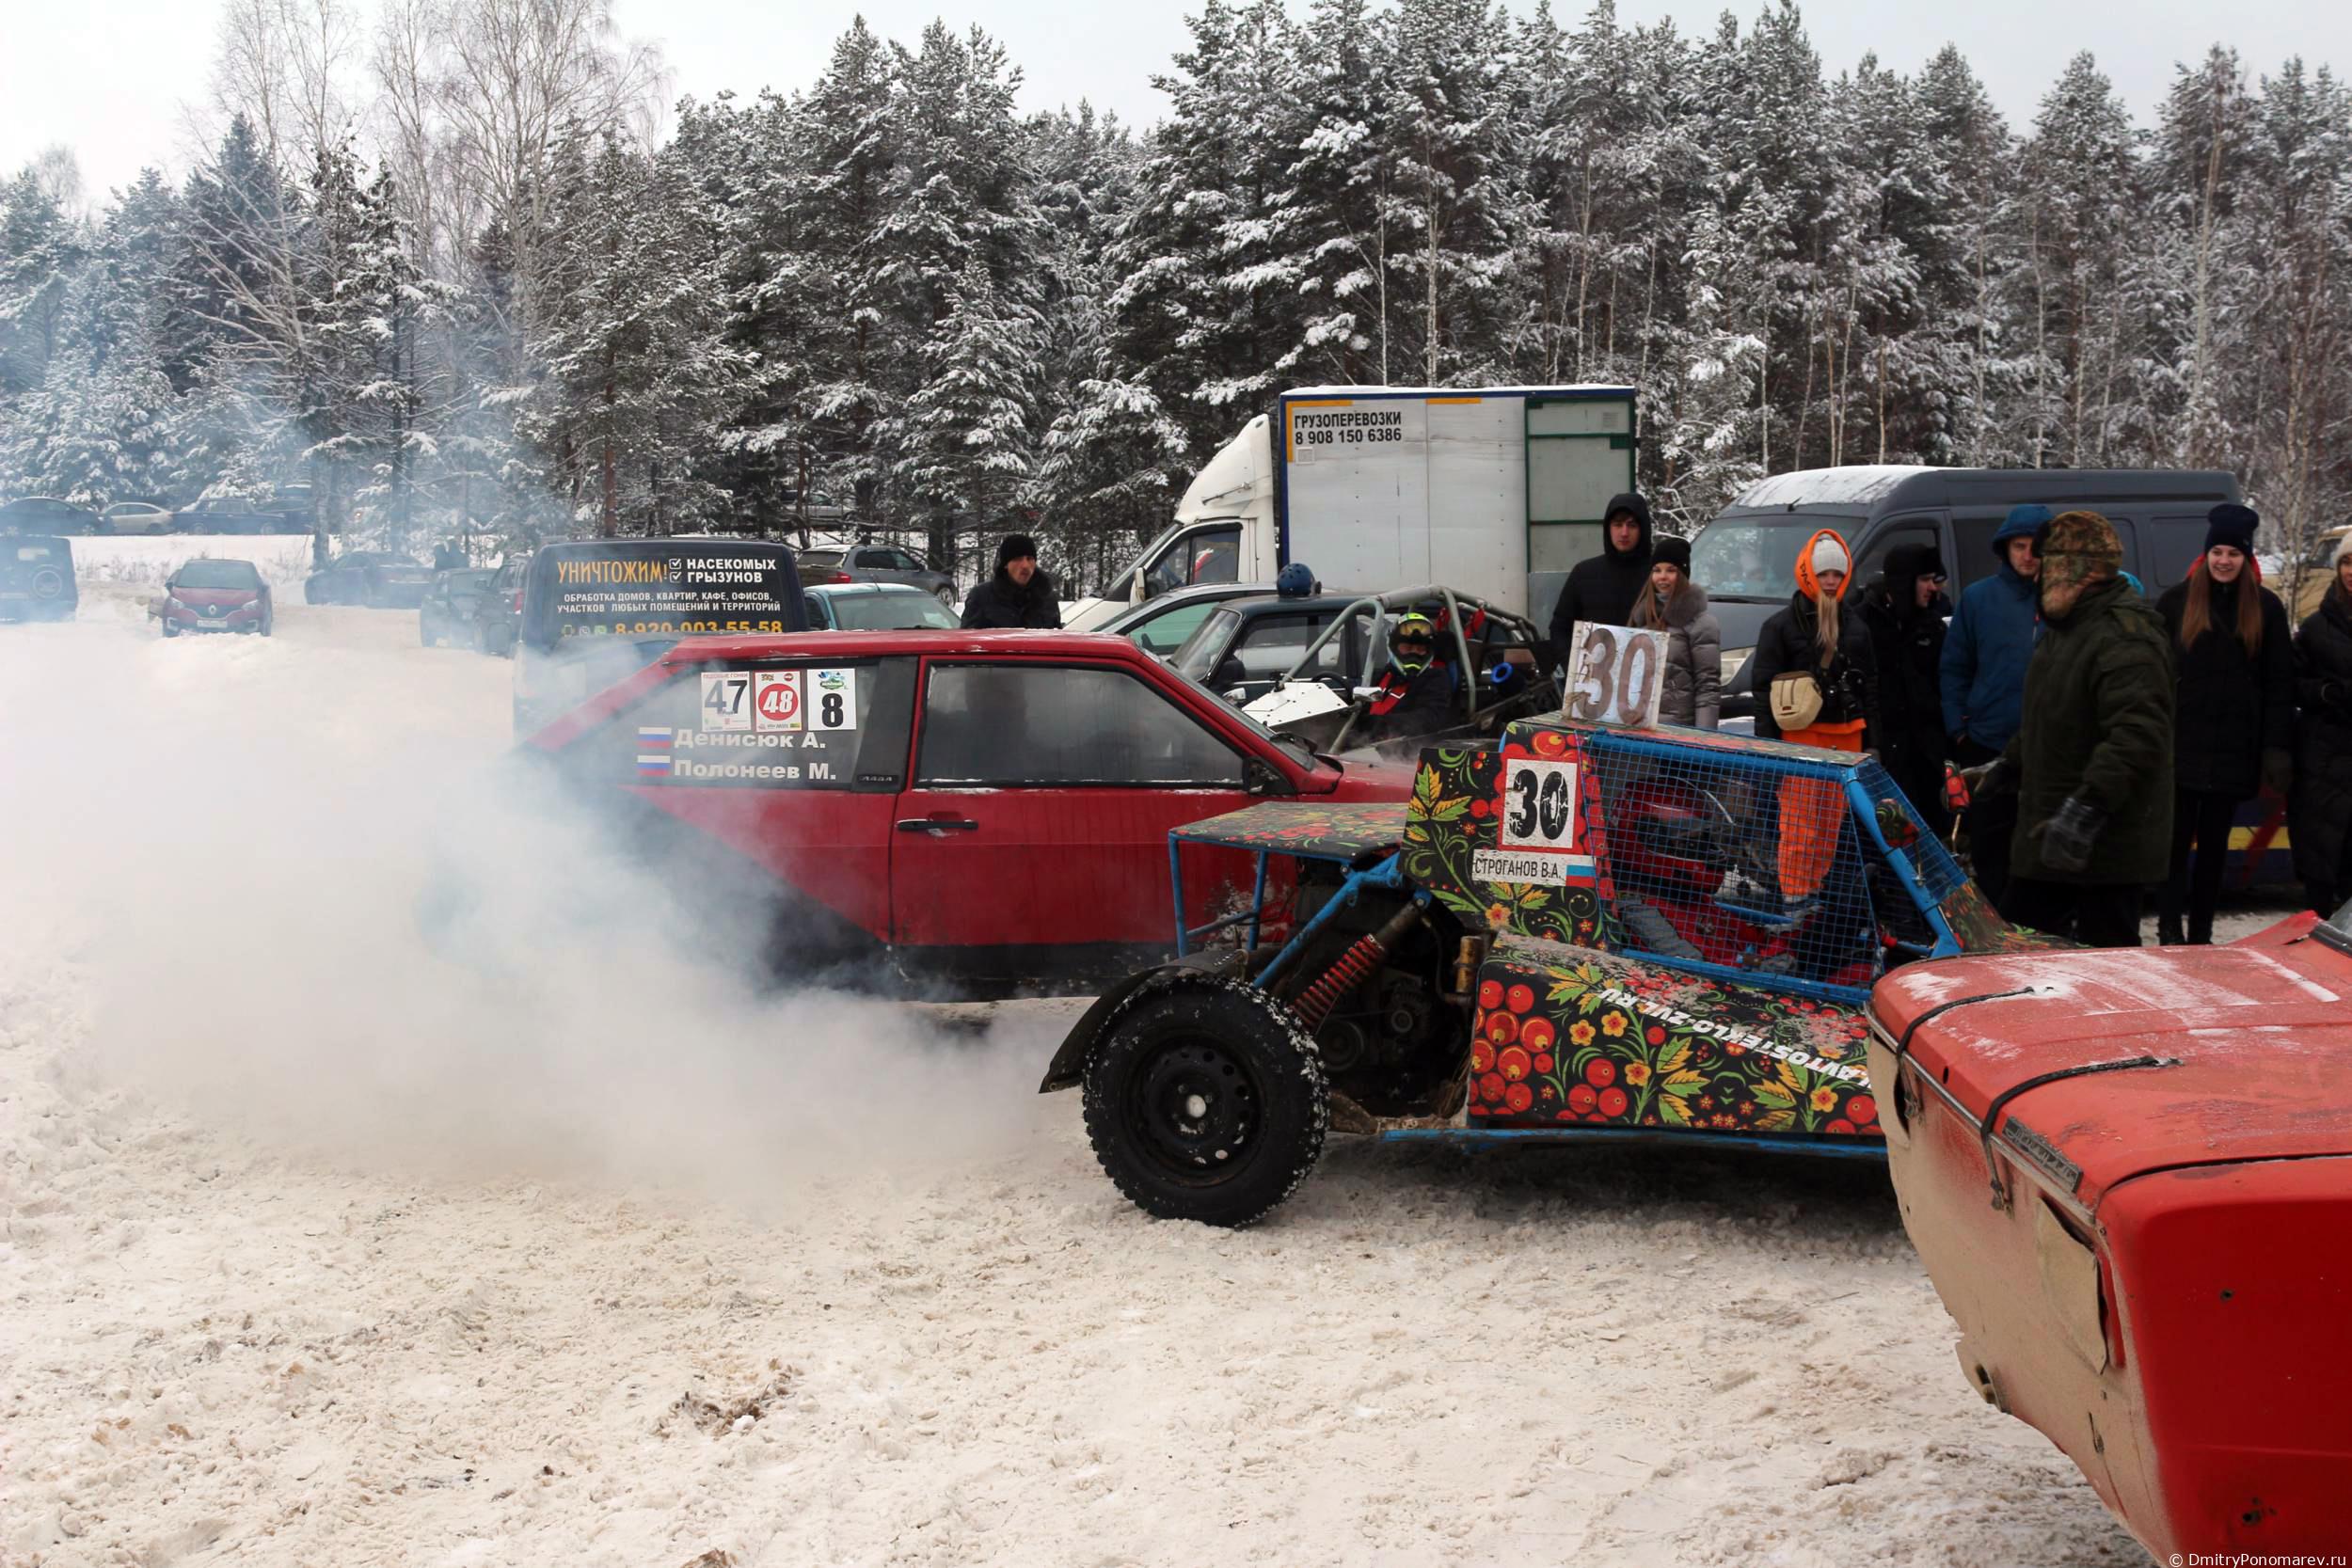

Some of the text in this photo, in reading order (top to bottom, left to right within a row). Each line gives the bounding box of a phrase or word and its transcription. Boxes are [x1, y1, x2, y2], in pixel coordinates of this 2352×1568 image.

[1295, 412, 1402, 429] ГРУЗОПЕРЕВОЗКИ
[1295, 428, 1402, 445] 8 908 150 6386
[557, 561, 668, 583] УНИЧТОЖИМ!
[687, 559, 776, 570] НАСЕКОМЫХ
[688, 572, 763, 582] ГРЫЗУНОВ
[557, 604, 605, 612] УЧАСТКОВ
[612, 603, 646, 611] ЛЮБЫХ
[650, 602, 709, 611] ПОМЕЩЕНИЙ
[722, 602, 781, 611] ТЕРРИТОРИЙ
[564, 594, 615, 602] ОБРАБОТКА
[702, 593, 729, 601] КАФЕ,
[732, 593, 772, 602] ОФИСОВ,
[1573, 628, 1656, 725] 30
[705, 679, 748, 715] 47
[763, 690, 793, 713] 48
[821, 693, 844, 727] 8
[674, 729, 826, 749] Денисюк А.
[674, 760, 835, 780] Полонеев М.
[1509, 769, 1568, 840] 30
[1474, 858, 1561, 879] СТРОГАНОВ В.А.
